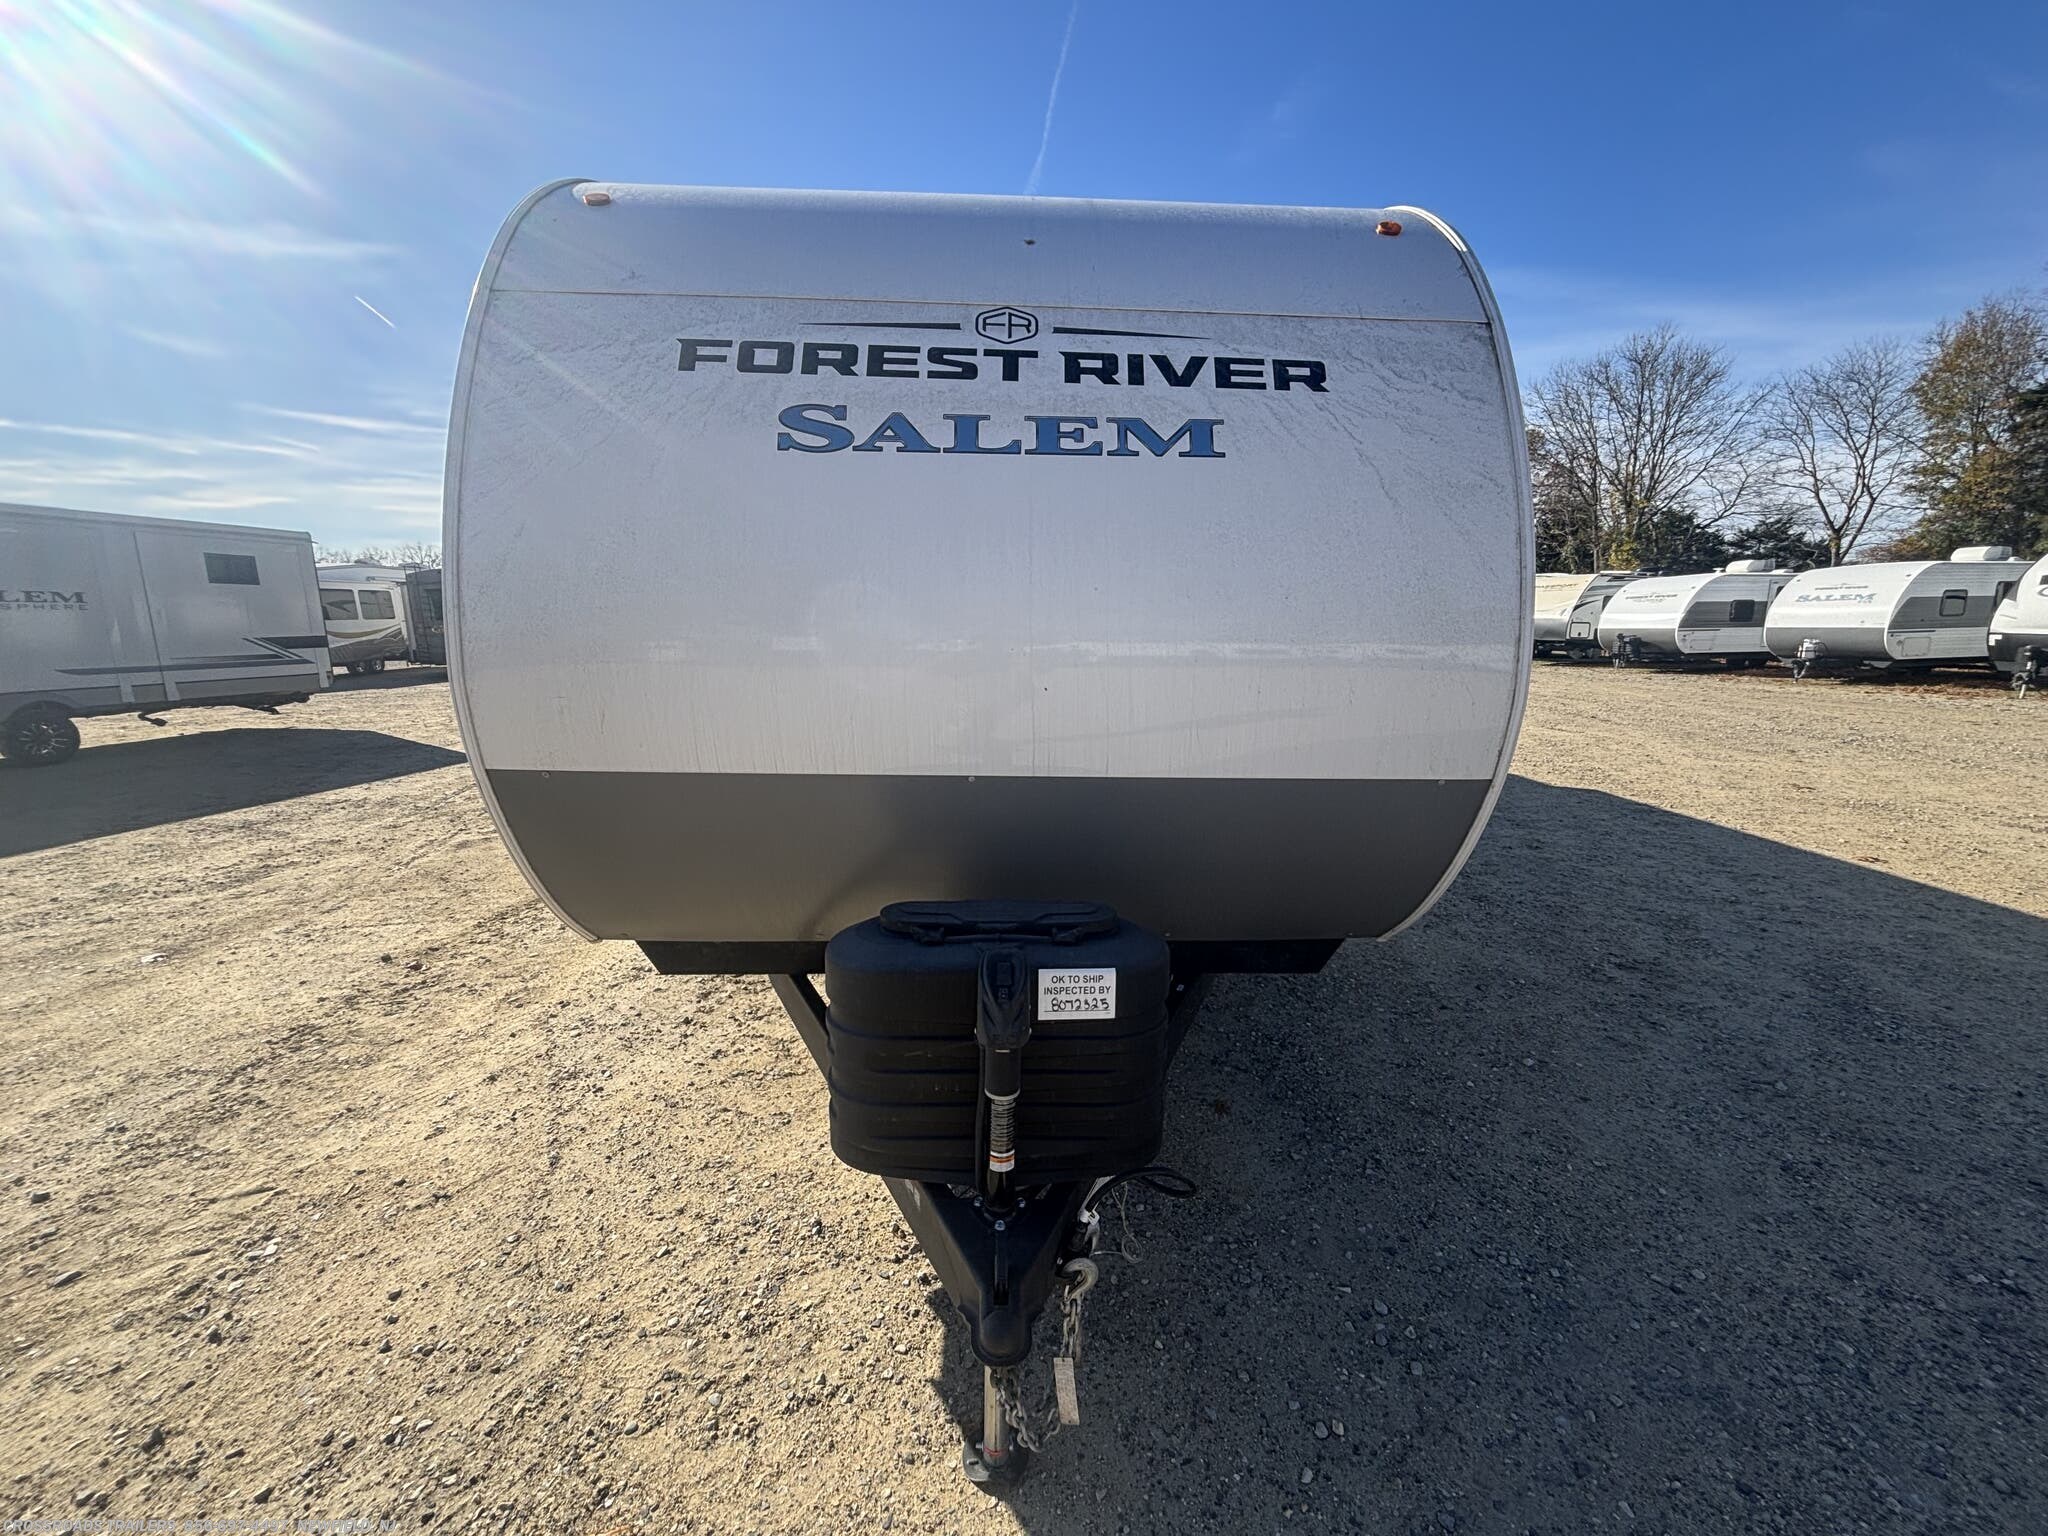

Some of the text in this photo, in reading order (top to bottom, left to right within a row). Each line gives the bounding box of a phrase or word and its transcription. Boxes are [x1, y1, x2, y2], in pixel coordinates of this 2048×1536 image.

[676, 338, 1329, 393] FOREST RIVER
[777, 403, 1226, 458] SALEM
[1043, 986, 1111, 995] INSPECTED BY
[1051, 974, 1104, 984] OK TO SHIP
